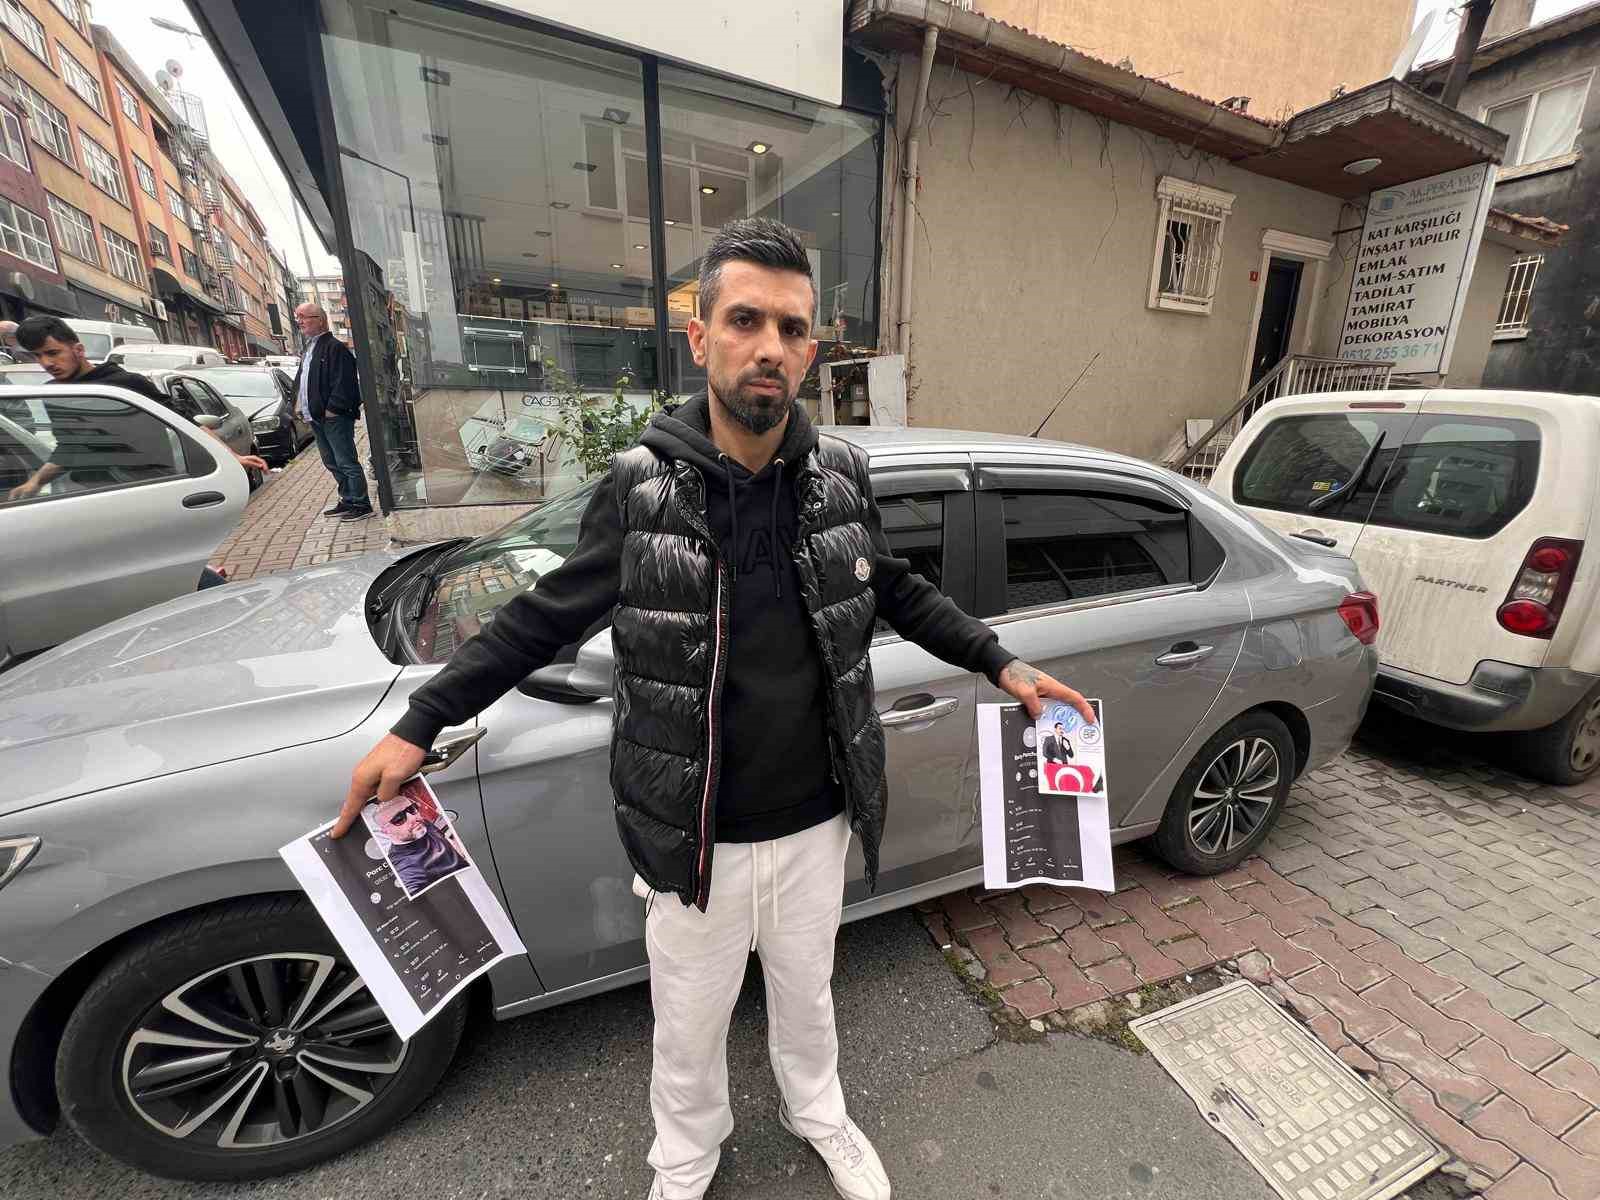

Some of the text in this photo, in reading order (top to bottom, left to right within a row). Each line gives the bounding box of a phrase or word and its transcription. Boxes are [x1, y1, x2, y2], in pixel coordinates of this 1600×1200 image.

[1367, 227, 1391, 241] KAT
[1394, 210, 1461, 235] KARŞILIĞI
[1409, 229, 1461, 248] YAPILIR
[1358, 255, 1408, 273] EMLAK
[1356, 263, 1446, 287] ALIM-SATIM
[1343, 326, 1446, 345] DEKORASYON
[1375, 346, 1399, 360] 255
[1400, 345, 1420, 359] 36
[1415, 575, 1488, 593] PARTNER
